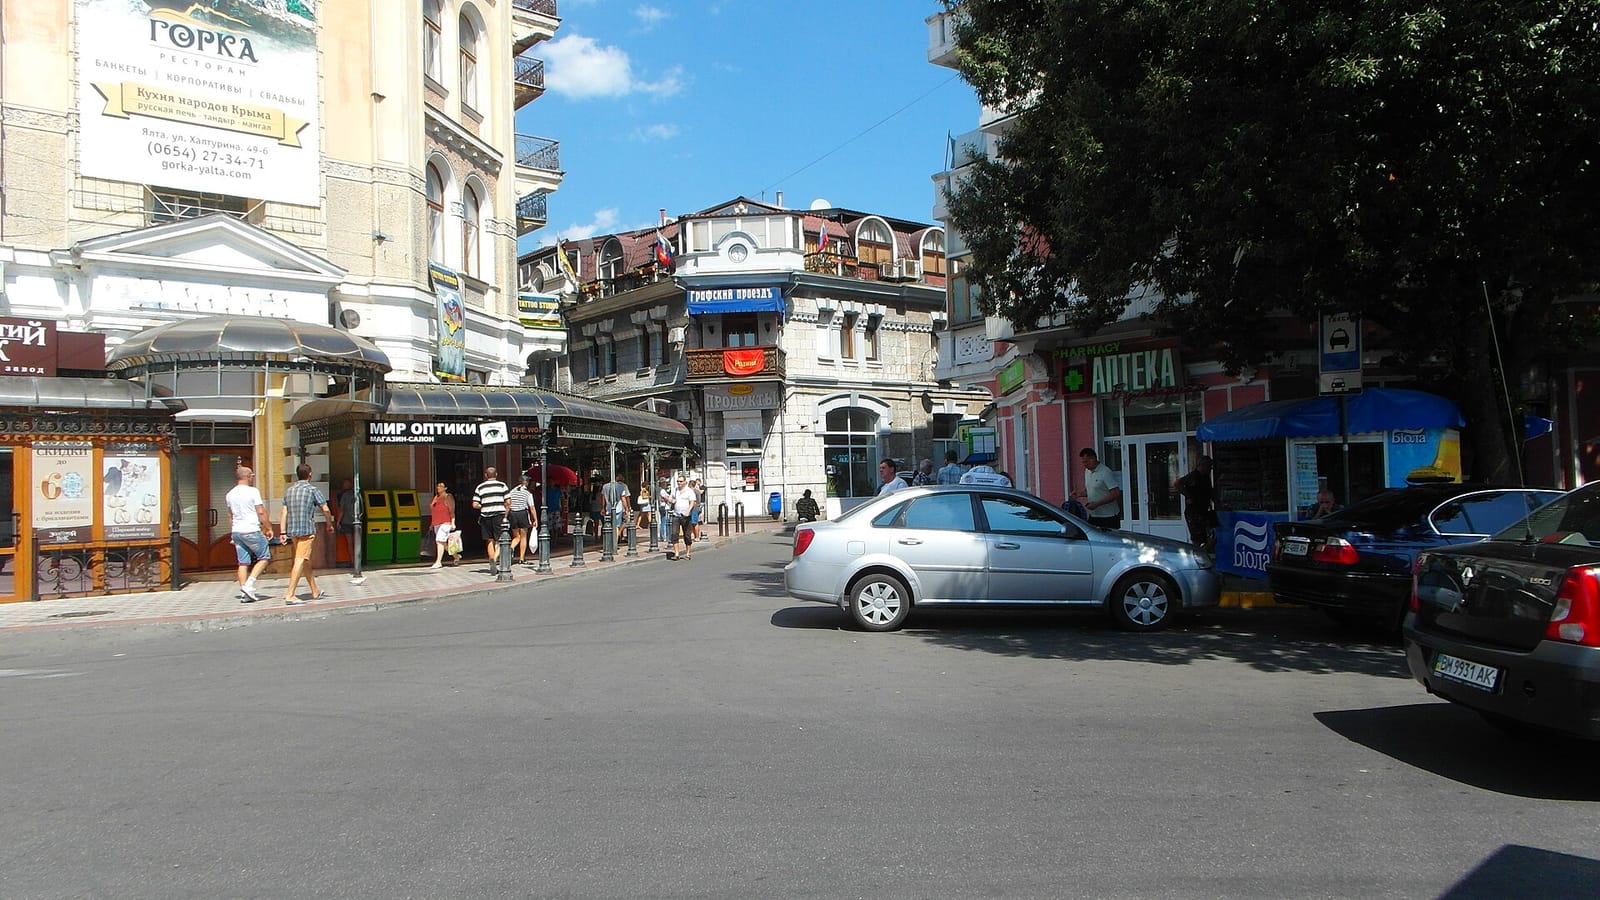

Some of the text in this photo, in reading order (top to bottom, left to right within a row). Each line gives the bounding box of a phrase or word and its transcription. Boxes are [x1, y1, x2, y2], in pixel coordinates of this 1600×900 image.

[150, 18, 259, 63] ГОРКА
[160, 52, 246, 76] РЕСТОРАН
[95, 59, 305, 106] БАНКЕТЫ КОРПОРАТИВЫ СВАДЬБЫ
[137, 87, 272, 121] Кухня народов Крыма
[137, 103, 272, 131] русская печь тандыр мангал
[172, 133, 187, 143] ул.
[147, 141, 265, 169] (0654) 27-34-71
[161, 160, 252, 179] gorka-yalta.com
[690, 287, 773, 303] Графский проездъ
[1052, 341, 1121, 359] PHARMACY
[1092, 348, 1176, 394] АПТЕКА
[705, 391, 779, 409] ПРОДУКТЫ
[370, 423, 477, 435] МИР ОПТИКИ
[36, 448, 88, 457] СКИДКИ
[1454, 660, 1476, 679] 9931
[1476, 668, 1495, 685] AK
